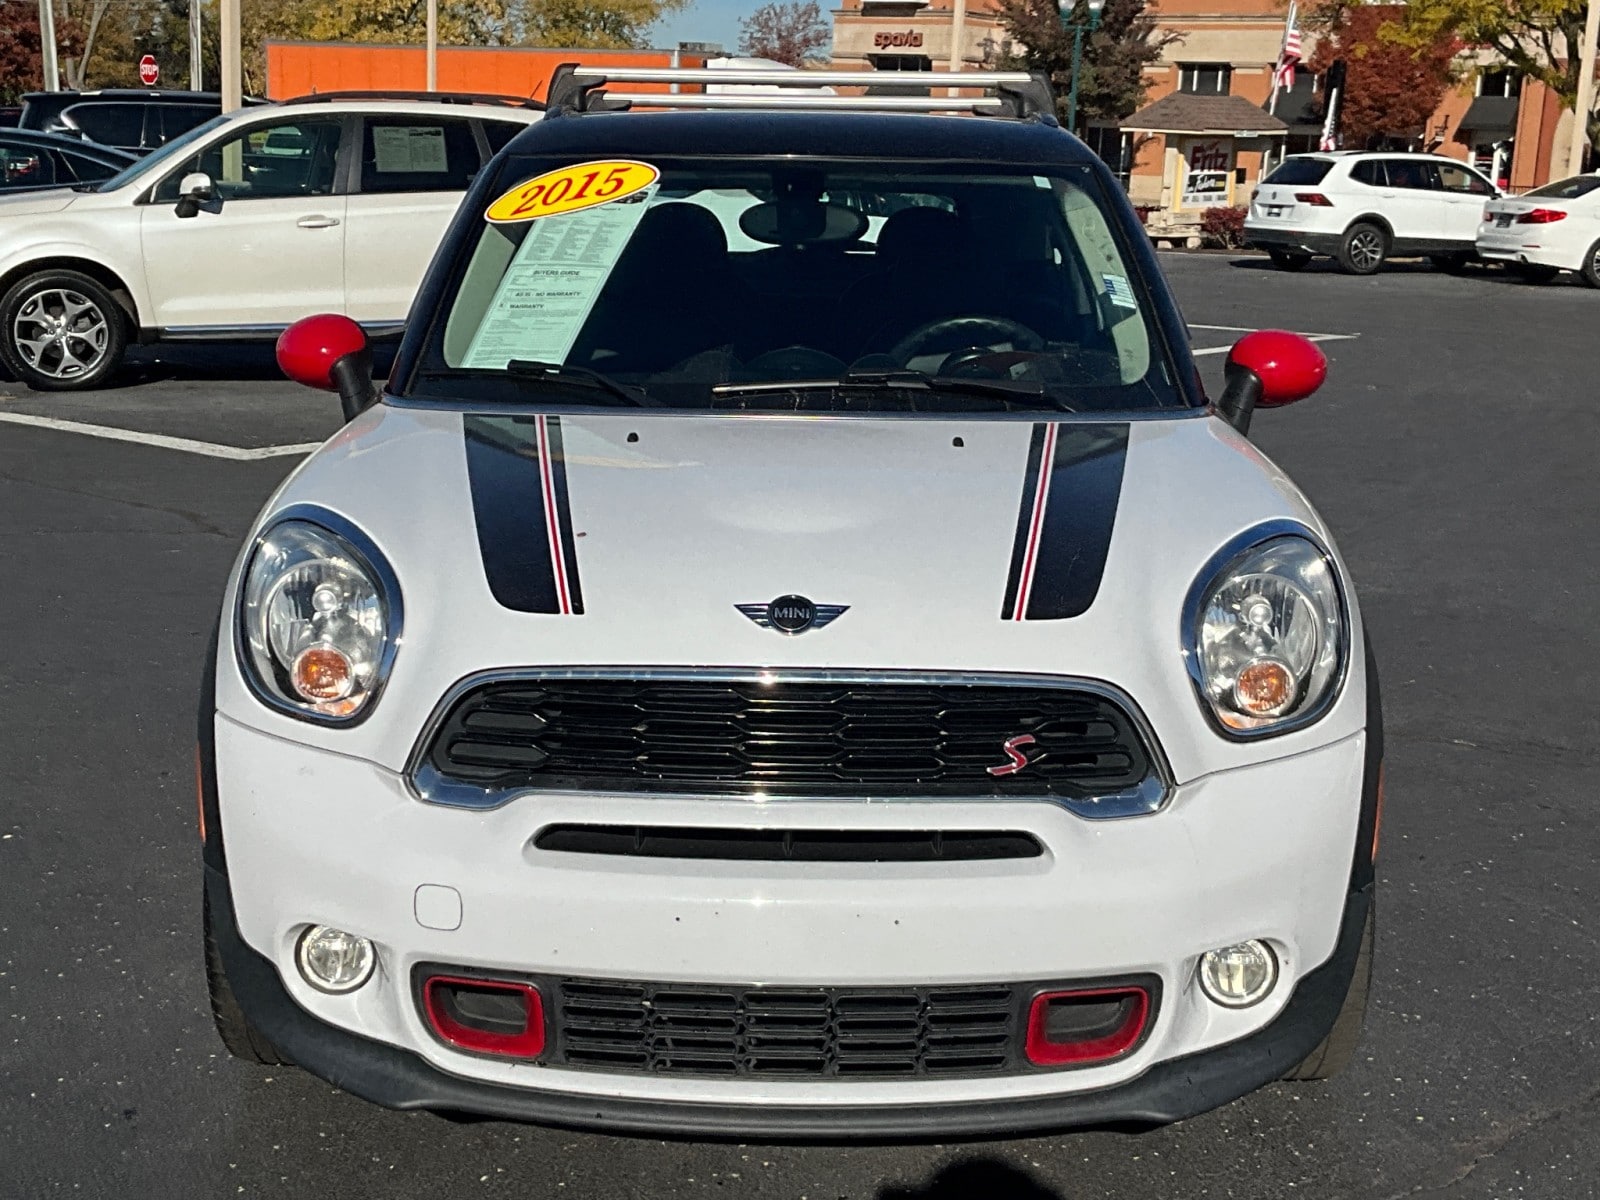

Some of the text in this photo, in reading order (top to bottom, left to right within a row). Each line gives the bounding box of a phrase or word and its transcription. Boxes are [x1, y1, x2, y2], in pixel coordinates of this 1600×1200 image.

[874, 29, 923, 50] spavia
[141, 64, 158, 76] STOP
[511, 167, 633, 216] 2015
[773, 606, 811, 620] MINI
[986, 734, 1036, 776] S
